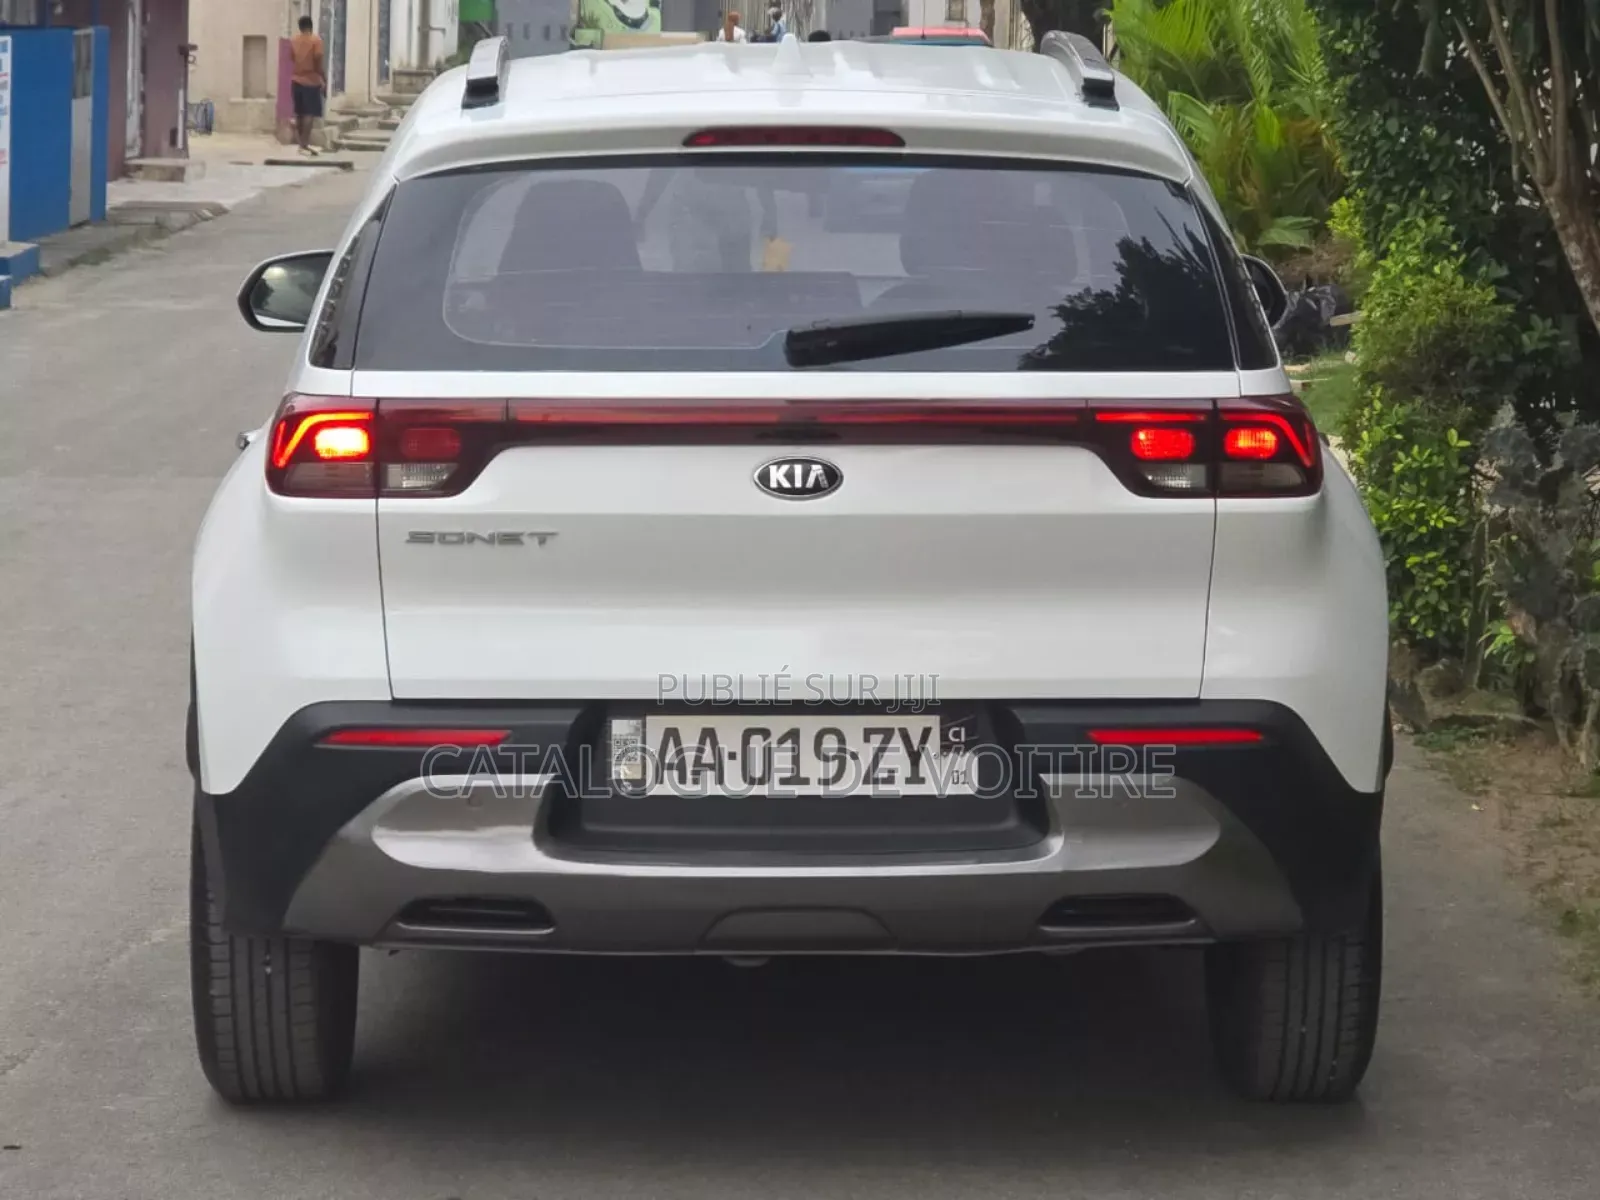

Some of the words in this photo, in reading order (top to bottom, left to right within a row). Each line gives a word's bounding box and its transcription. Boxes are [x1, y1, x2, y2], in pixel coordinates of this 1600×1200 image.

[769, 464, 829, 489] KIA
[405, 530, 560, 547] SONET
[948, 726, 966, 742] CI
[952, 769, 970, 785] 01
